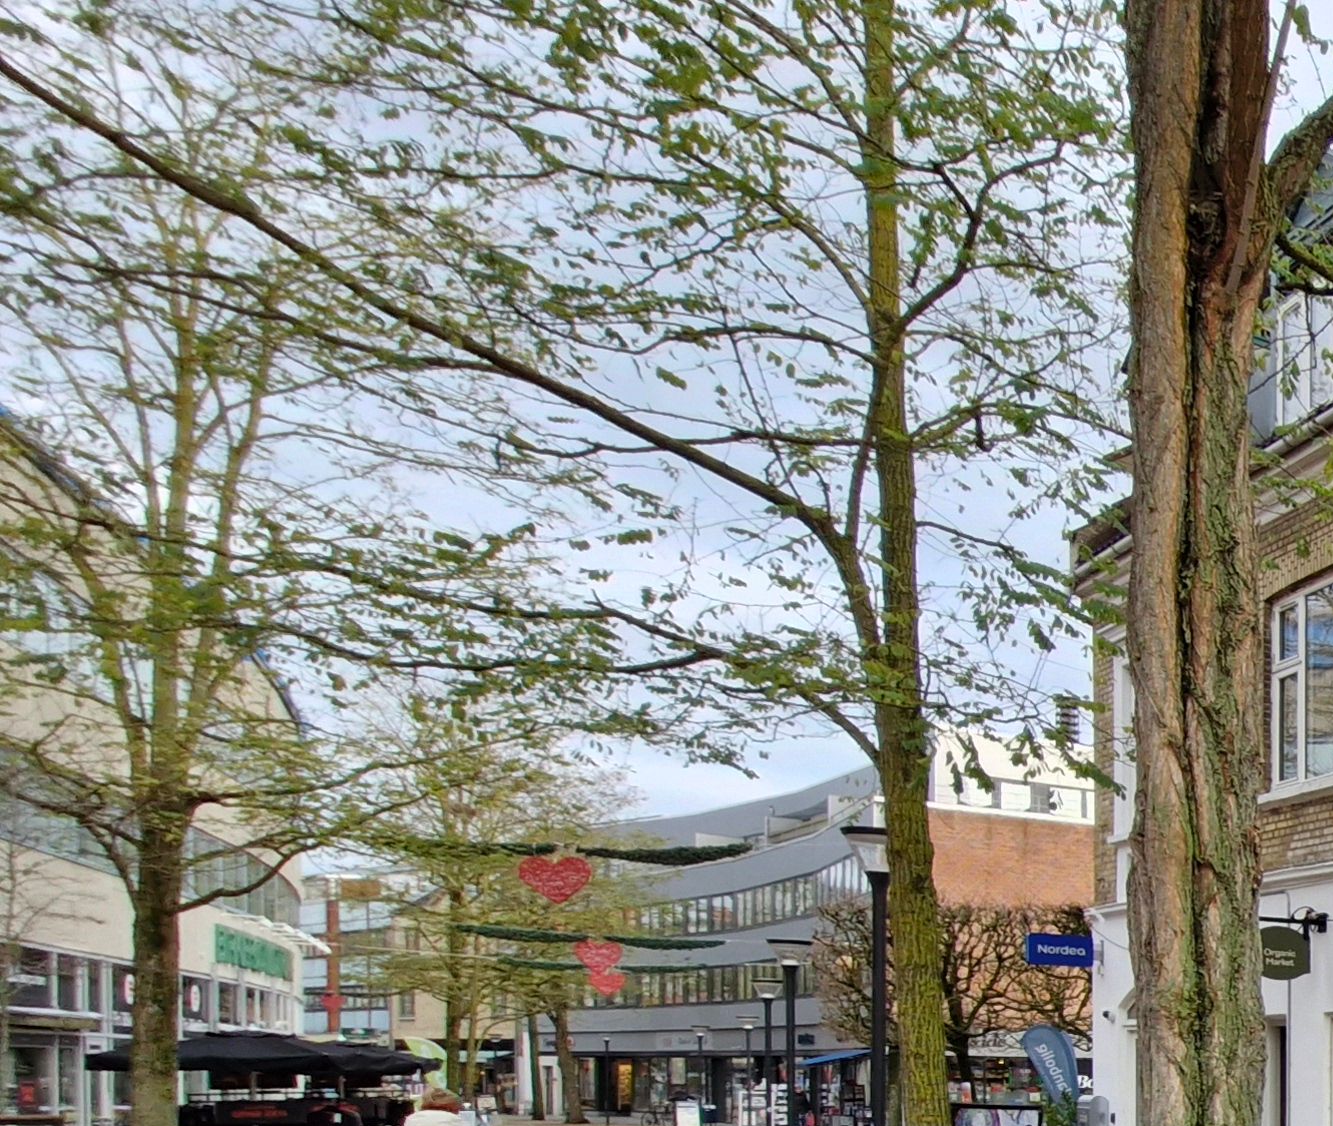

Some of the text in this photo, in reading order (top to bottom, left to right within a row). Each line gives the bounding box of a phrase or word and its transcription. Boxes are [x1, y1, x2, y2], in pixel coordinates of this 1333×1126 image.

[1037, 944, 1086, 957] Nordea
[1263, 947, 1297, 959] Organic
[1265, 957, 1296, 967] Market
